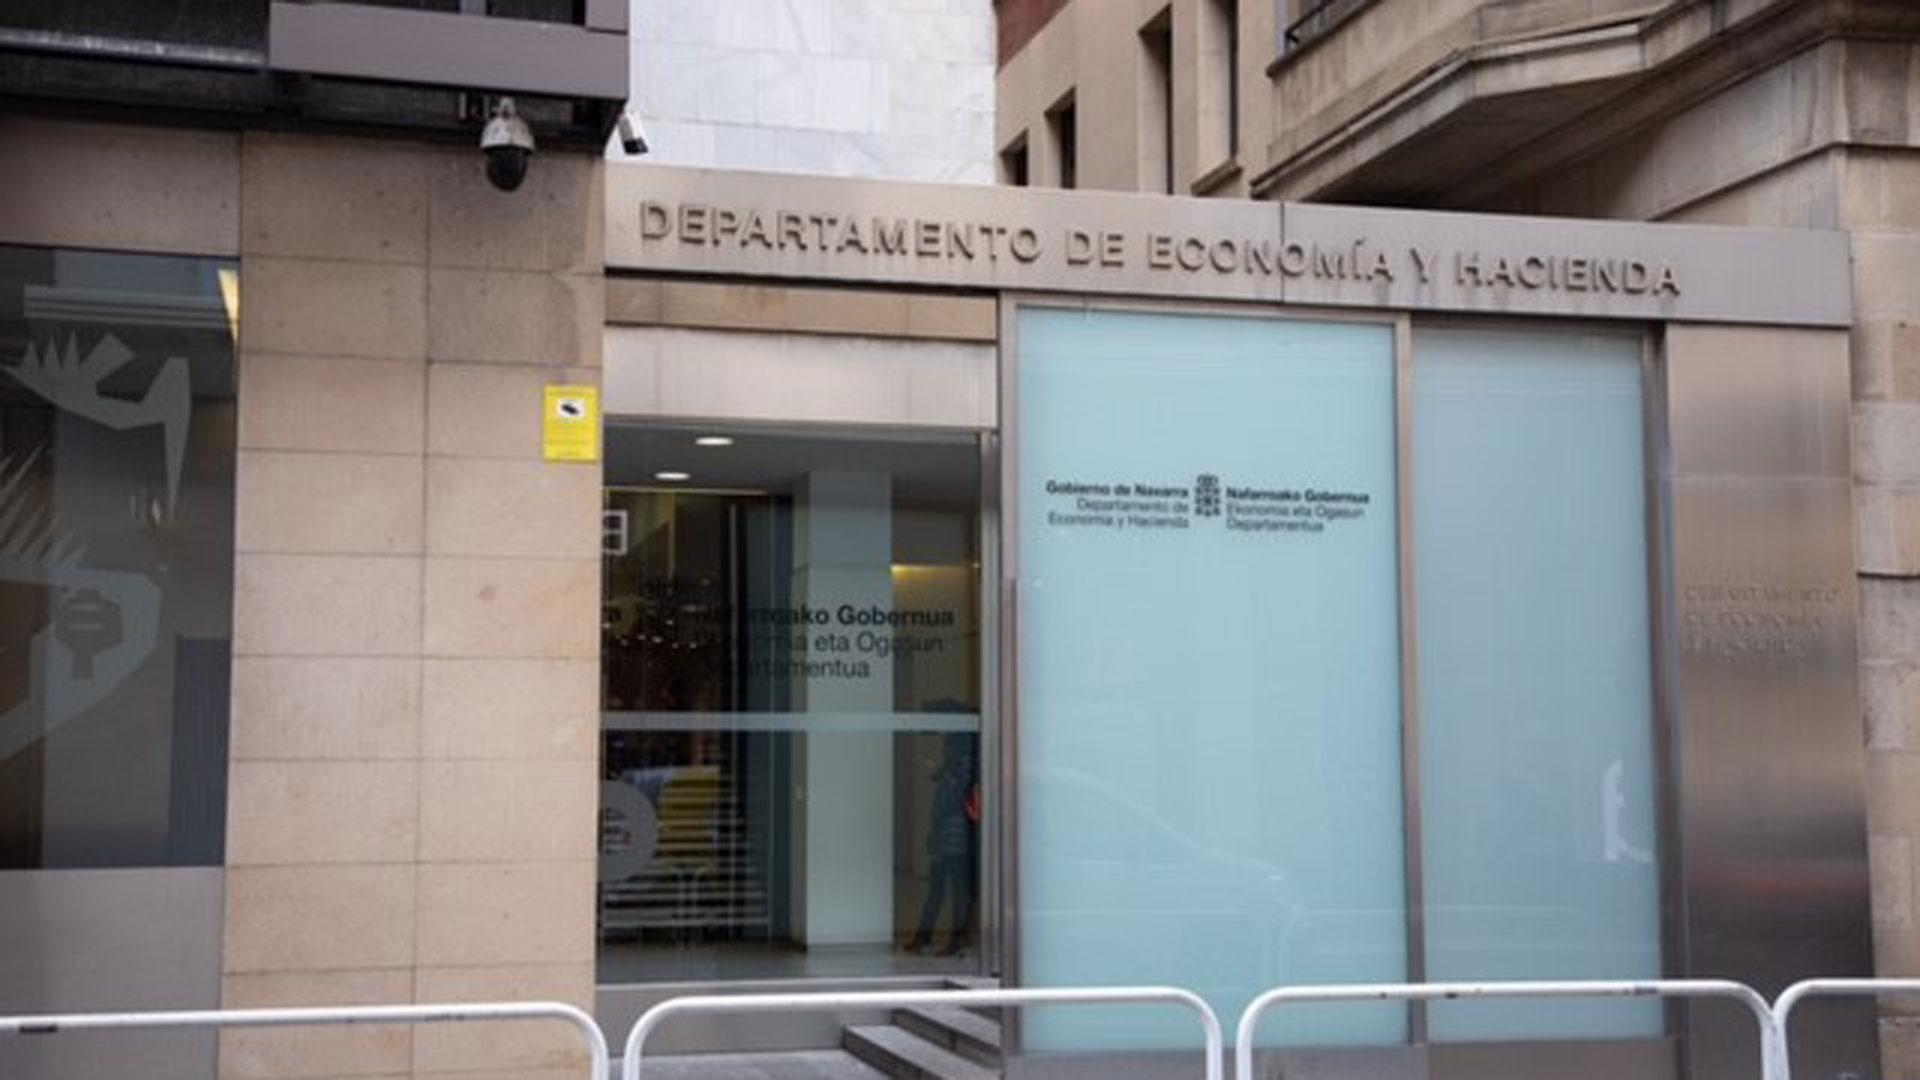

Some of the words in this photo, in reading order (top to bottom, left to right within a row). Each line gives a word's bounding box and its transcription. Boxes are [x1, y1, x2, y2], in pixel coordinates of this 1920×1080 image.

[640, 201, 1043, 264] DEPARTAMENTO
[1066, 230, 1125, 268] DE
[1148, 234, 1394, 282] ECONOMÍA
[1409, 247, 1440, 285] Y
[1456, 250, 1681, 297] HACIENDA
[1046, 480, 1111, 496] Gobierno
[1114, 484, 1131, 496] de
[1134, 484, 1189, 498] Navarra
[1172, 501, 1189, 513] de
[837, 604, 955, 628] Gobernua
[814, 633, 850, 652] eta
[855, 632, 944, 660] Ogasun
